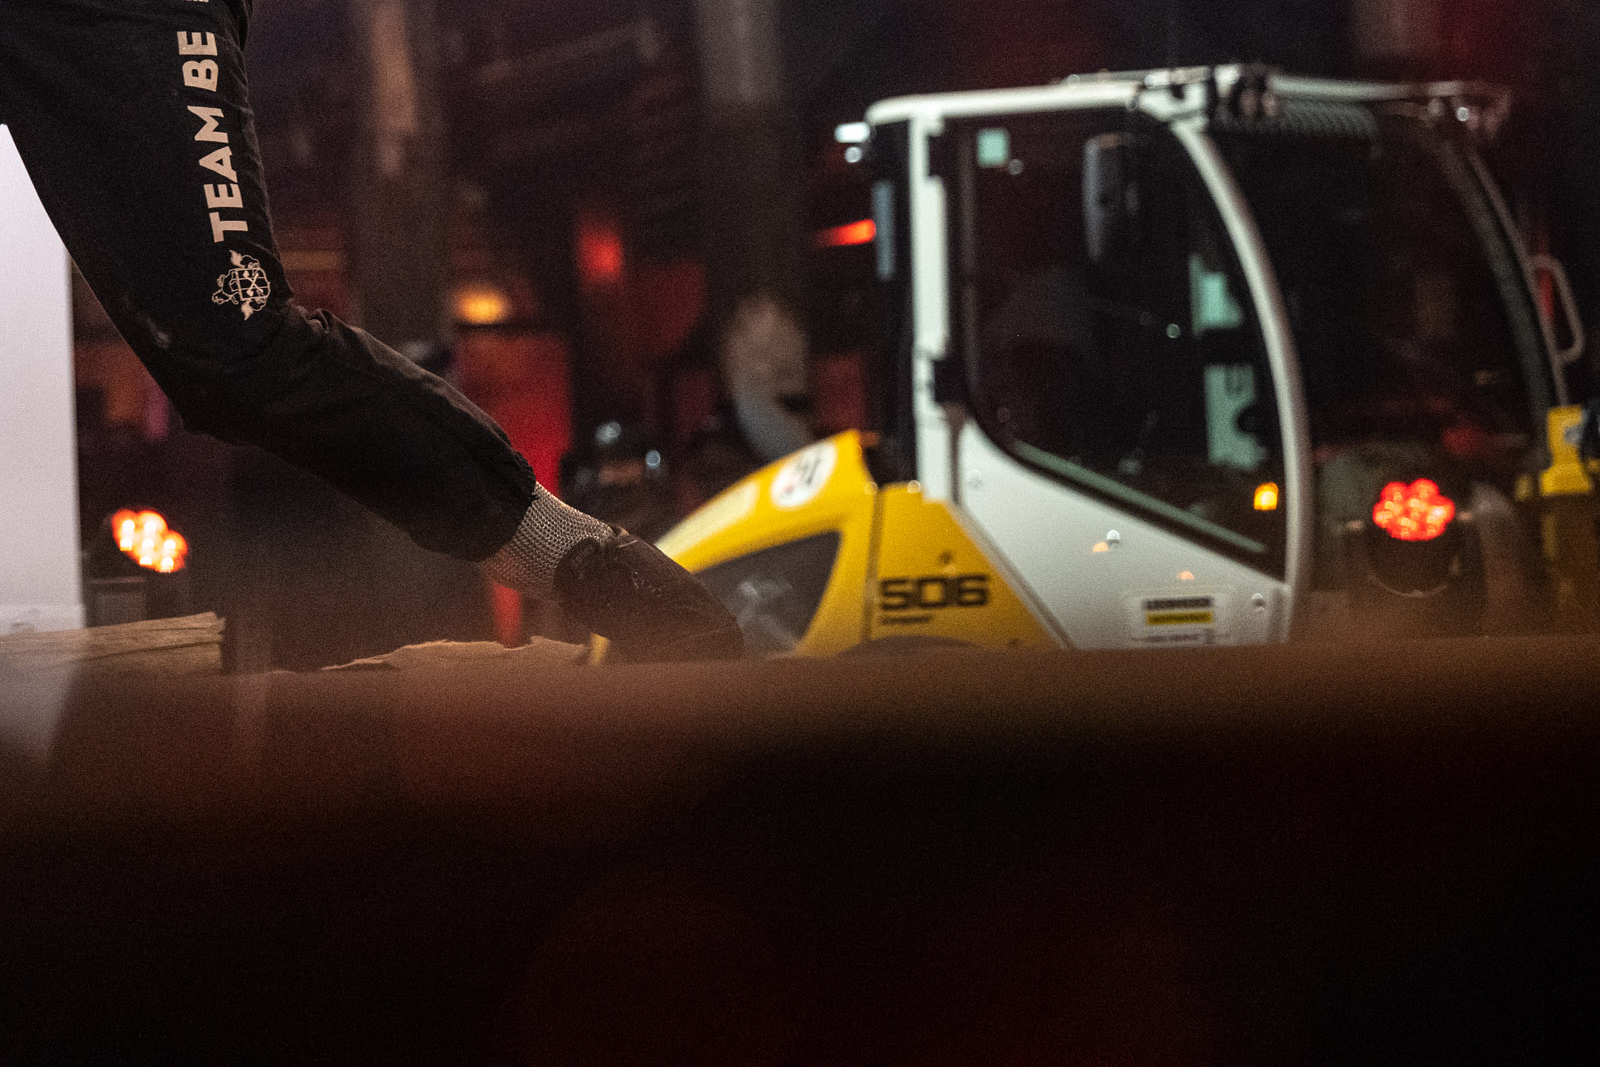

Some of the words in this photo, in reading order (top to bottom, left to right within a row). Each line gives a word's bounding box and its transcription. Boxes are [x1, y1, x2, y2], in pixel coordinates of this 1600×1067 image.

[176, 31, 219, 92] BE
[187, 105, 249, 243] TEAM
[881, 575, 989, 611] 506
